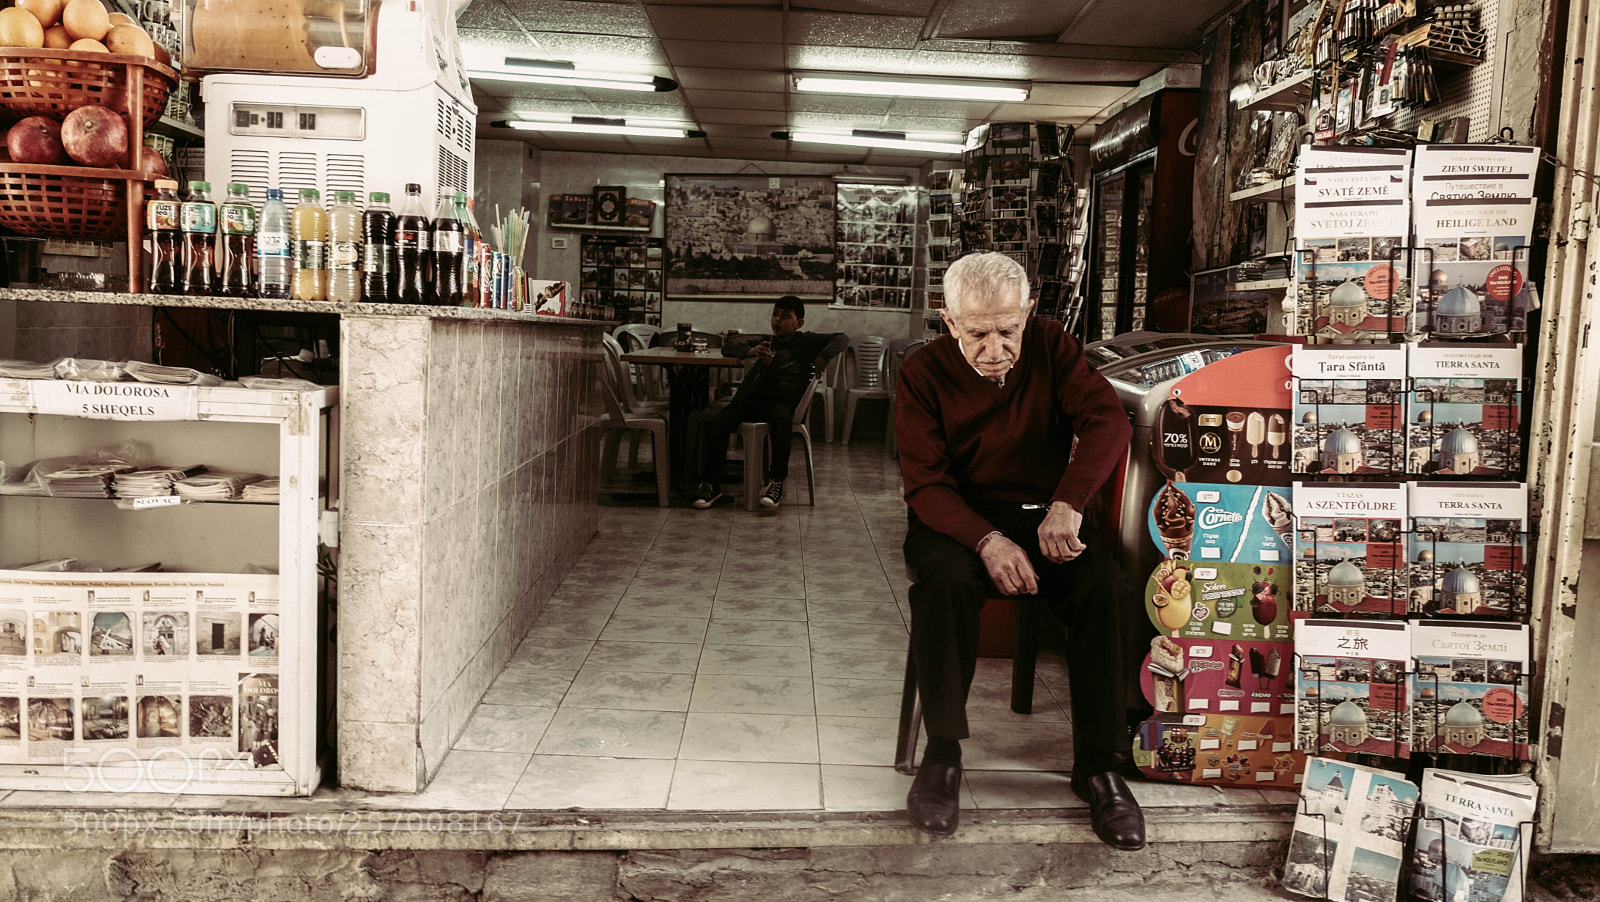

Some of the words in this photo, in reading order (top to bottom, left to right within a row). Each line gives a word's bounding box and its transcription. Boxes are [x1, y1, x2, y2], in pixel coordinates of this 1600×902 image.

[1318, 186, 1355, 197] SVATÉ
[1357, 185, 1389, 196] ZEMĚ
[1445, 182, 1497, 191] Путешествие
[1310, 219, 1354, 229] SVETOJ
[1436, 218, 1485, 228] HEILIGE
[1486, 217, 1518, 227] LAND
[1488, 265, 1518, 278] INCLUDIG
[1348, 361, 1386, 371] Sfântă
[1435, 360, 1469, 368] TIERRA
[1471, 361, 1500, 369] SANTA
[65, 383, 90, 395] VIA
[94, 384, 170, 398] DOLOROSA
[82, 403, 89, 413] 5
[91, 403, 155, 416] SHEQELS
[1163, 432, 1188, 444] 70%
[1305, 501, 1313, 509] A
[1315, 499, 1397, 511] SZENTFÖLDRE
[1438, 501, 1470, 509] TERRA
[1471, 501, 1503, 510] SANTA
[1198, 506, 1243, 530] Cornetto
[1336, 636, 1369, 651] 之旅
[1431, 638, 1470, 650] Святої
[1473, 640, 1508, 651] Землі
[1486, 688, 1516, 699] INCLUDIN
[1444, 792, 1482, 810] TERRA
[1484, 804, 1514, 817] SANTA
